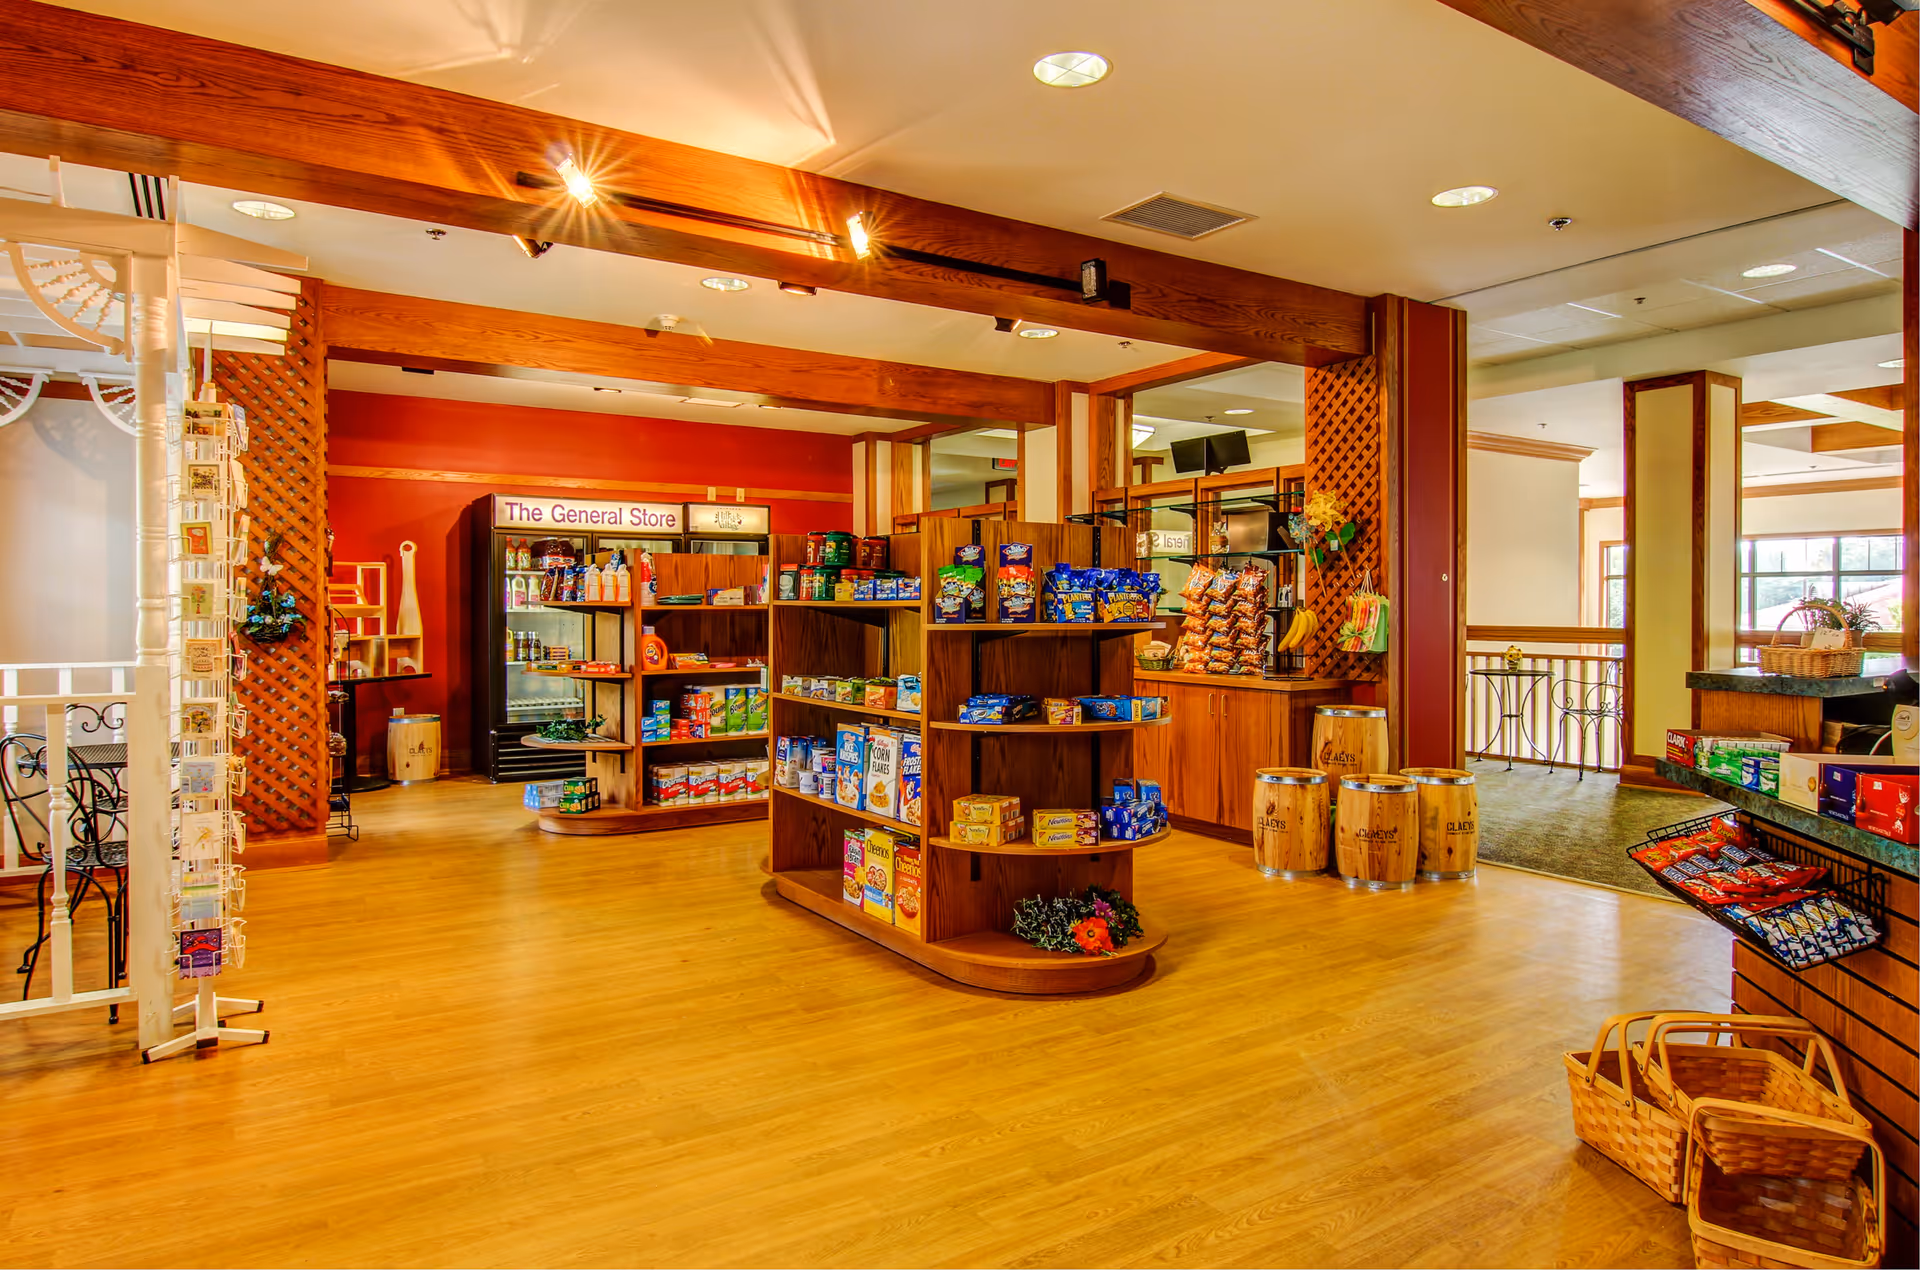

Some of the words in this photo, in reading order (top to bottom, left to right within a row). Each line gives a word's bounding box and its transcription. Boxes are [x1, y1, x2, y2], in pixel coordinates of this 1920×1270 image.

[505, 502, 543, 522] The
[551, 504, 623, 525] General
[630, 507, 676, 528] Store
[730, 700, 747, 715] Boun
[750, 700, 767, 715] Boun
[1667, 731, 1686, 748] CLARK
[873, 746, 890, 762] CORN
[1324, 752, 1356, 762] CLAEYS
[872, 761, 890, 775] FLAKES
[903, 756, 921, 767] FROST
[903, 764, 921, 775] FLAKE
[1047, 818, 1073, 826] Newtons
[1258, 816, 1286, 830] CLAEYS
[1447, 820, 1475, 832] CLAEYS
[1047, 834, 1073, 842] Newtons
[1358, 828, 1395, 840] CLAEYS
[866, 839, 890, 859] Cheerios
[895, 856, 921, 878] Cheerios
